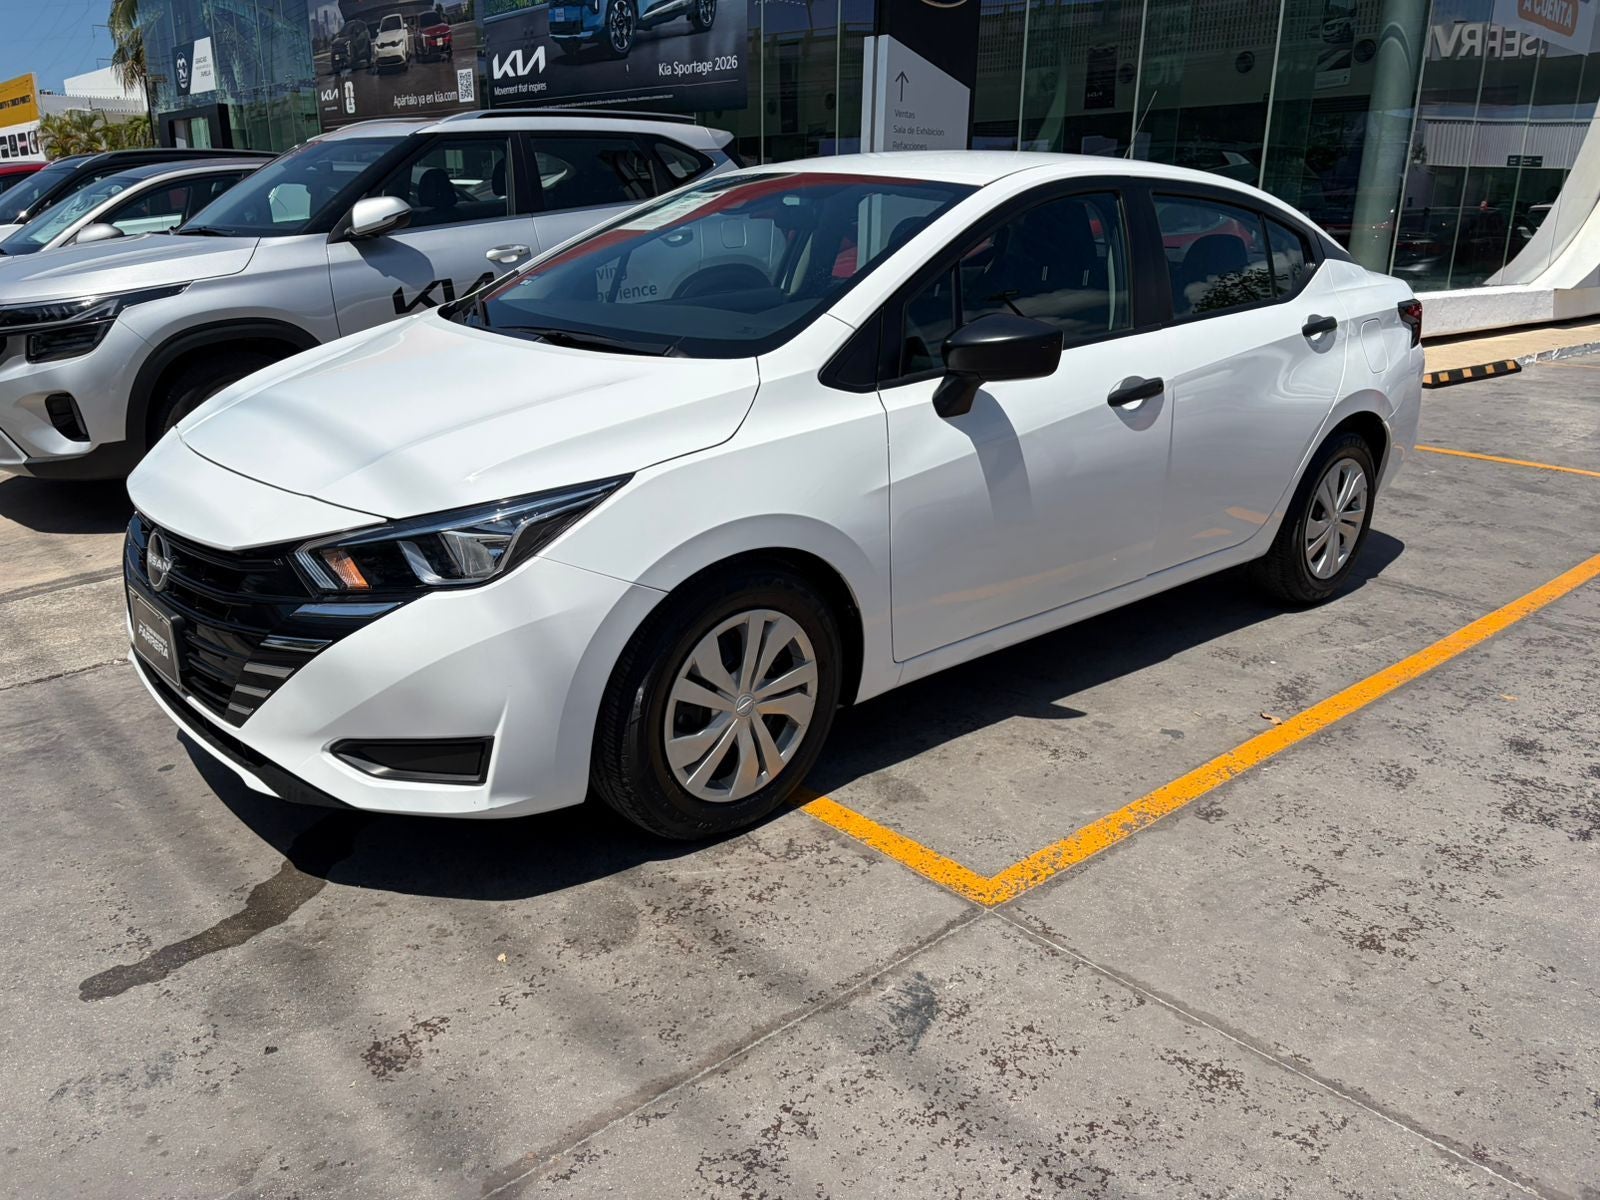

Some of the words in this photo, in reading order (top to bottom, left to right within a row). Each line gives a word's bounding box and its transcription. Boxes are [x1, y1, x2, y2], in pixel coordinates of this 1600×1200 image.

[1534, 0, 1572, 28] CUENTA
[492, 45, 546, 80] KIA
[658, 63, 672, 76] Kia
[673, 60, 713, 77] Sportage
[714, 55, 738, 71] 2026
[320, 88, 339, 102] KIA
[494, 86, 518, 96] Movement
[518, 83, 528, 93] that
[528, 81, 547, 93] inspires
[418, 95, 426, 107] ya
[426, 94, 434, 104] en
[434, 90, 458, 103] kia.com
[894, 109, 916, 119] Ventas
[892, 125, 906, 134] Sala
[907, 126, 914, 135] de
